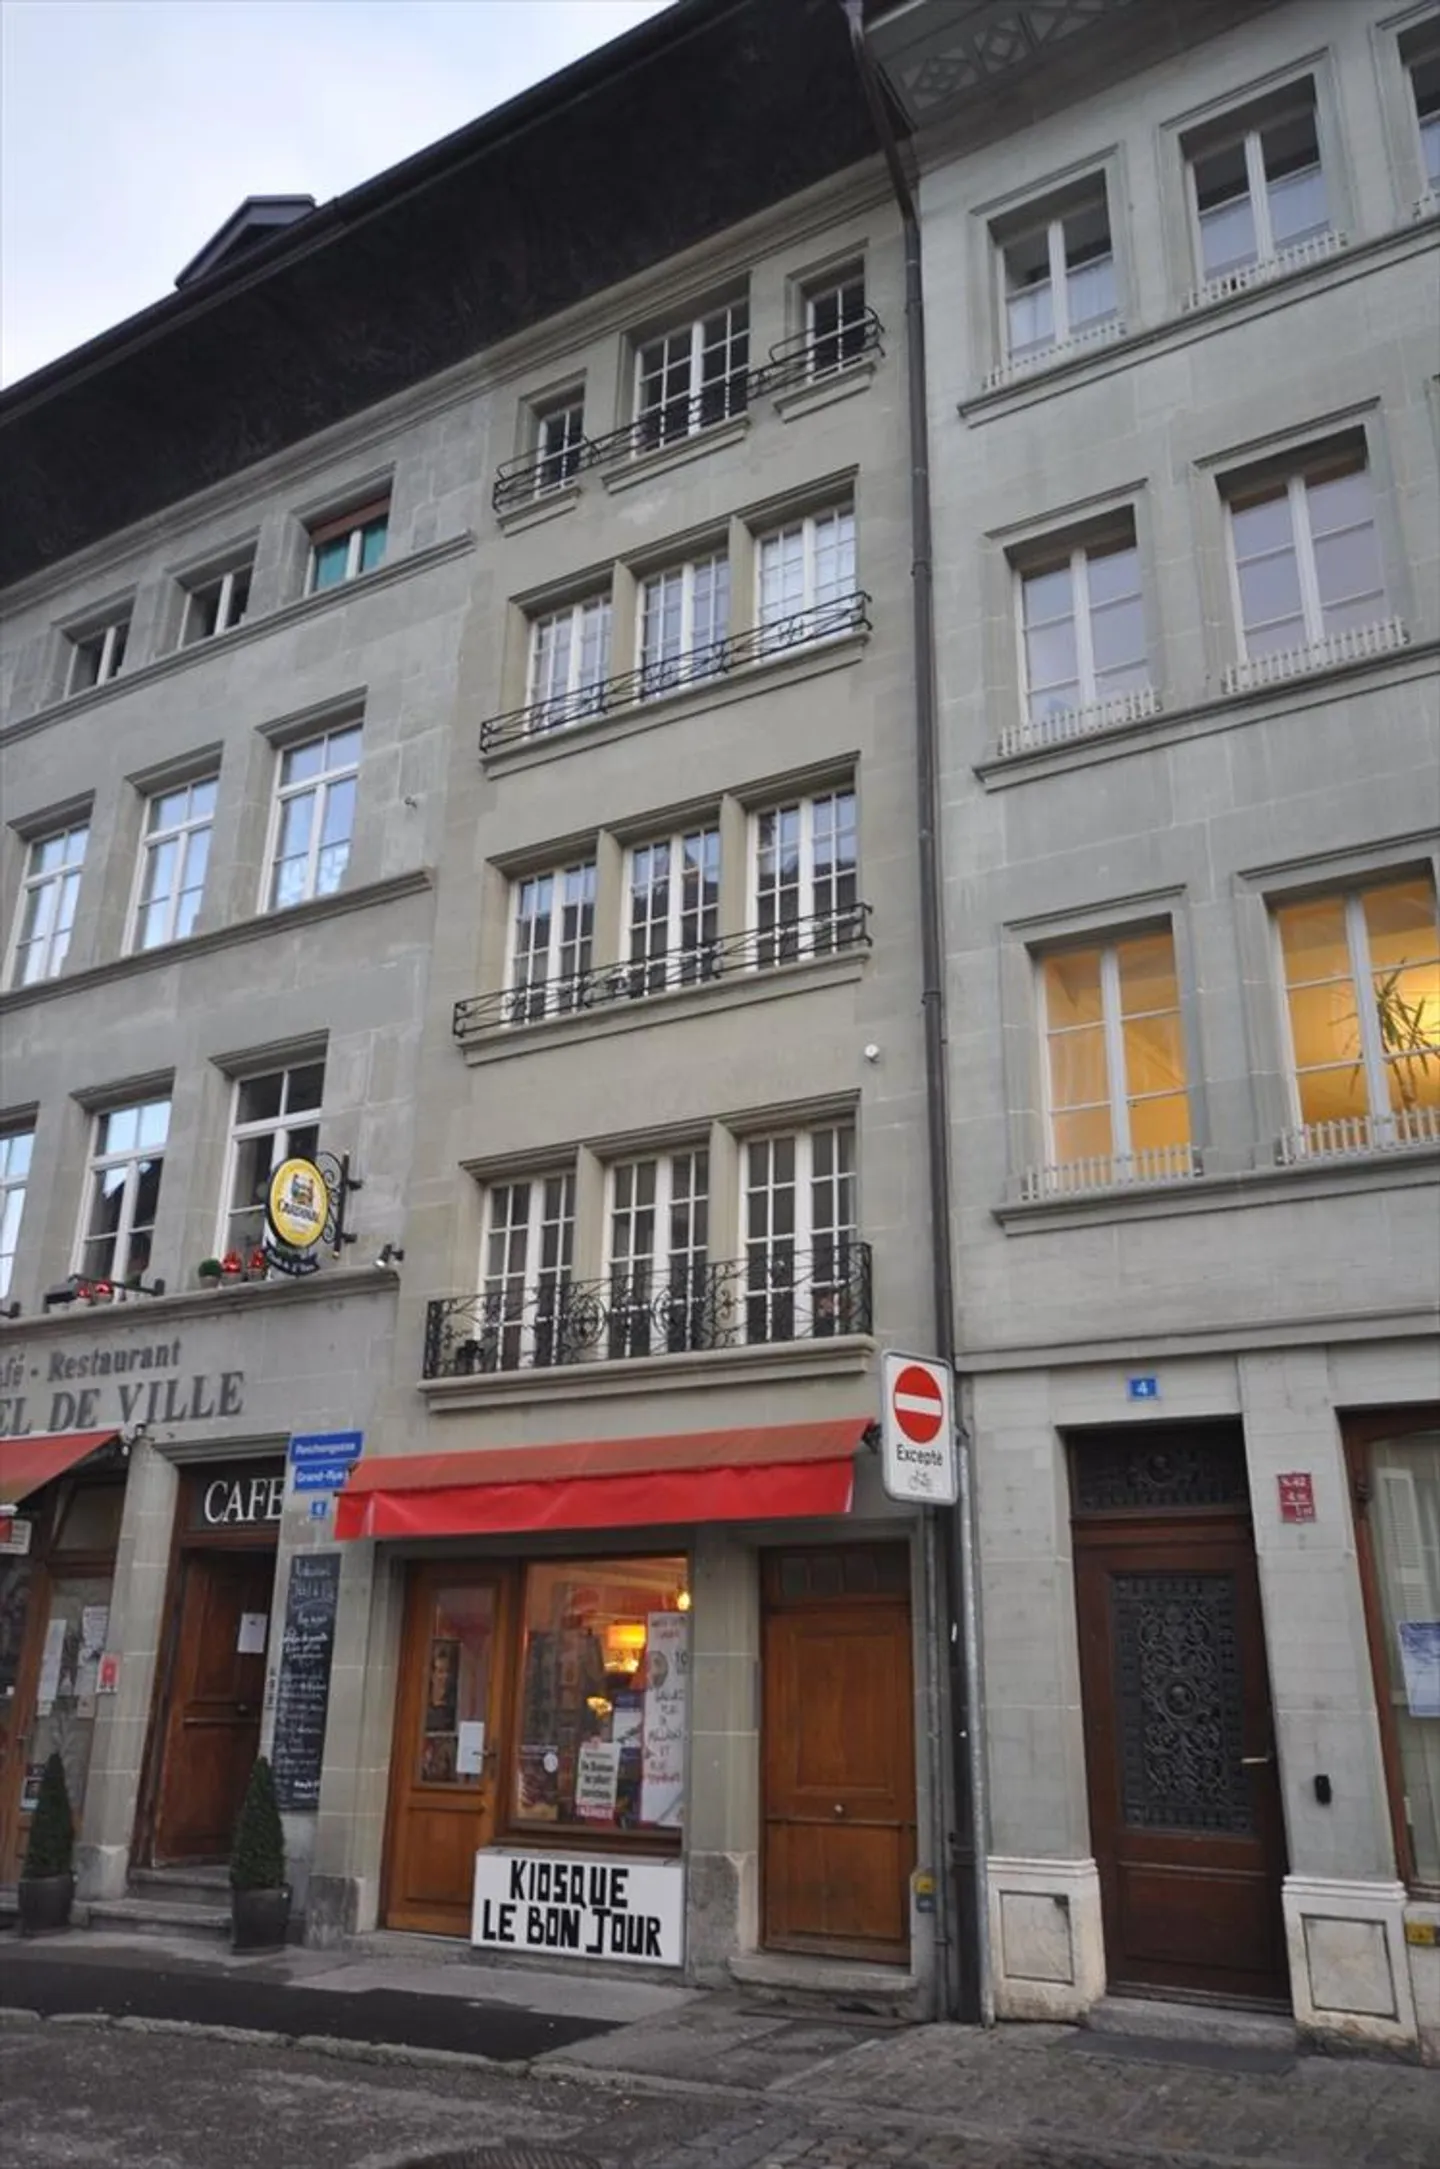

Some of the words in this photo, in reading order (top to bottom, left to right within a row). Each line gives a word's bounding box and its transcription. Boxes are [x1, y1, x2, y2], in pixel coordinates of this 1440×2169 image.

[47, 1337, 181, 1382] Restaurant
[48, 1387, 100, 1433] DE
[118, 1370, 245, 1424] VILLE
[1135, 1380, 1148, 1395] 4
[896, 1444, 943, 1466] Excepté
[510, 1859, 629, 1908] KIOSQUE
[482, 1899, 515, 1943] LE
[526, 1906, 581, 1949] BON
[583, 1907, 663, 1957] JOUR
